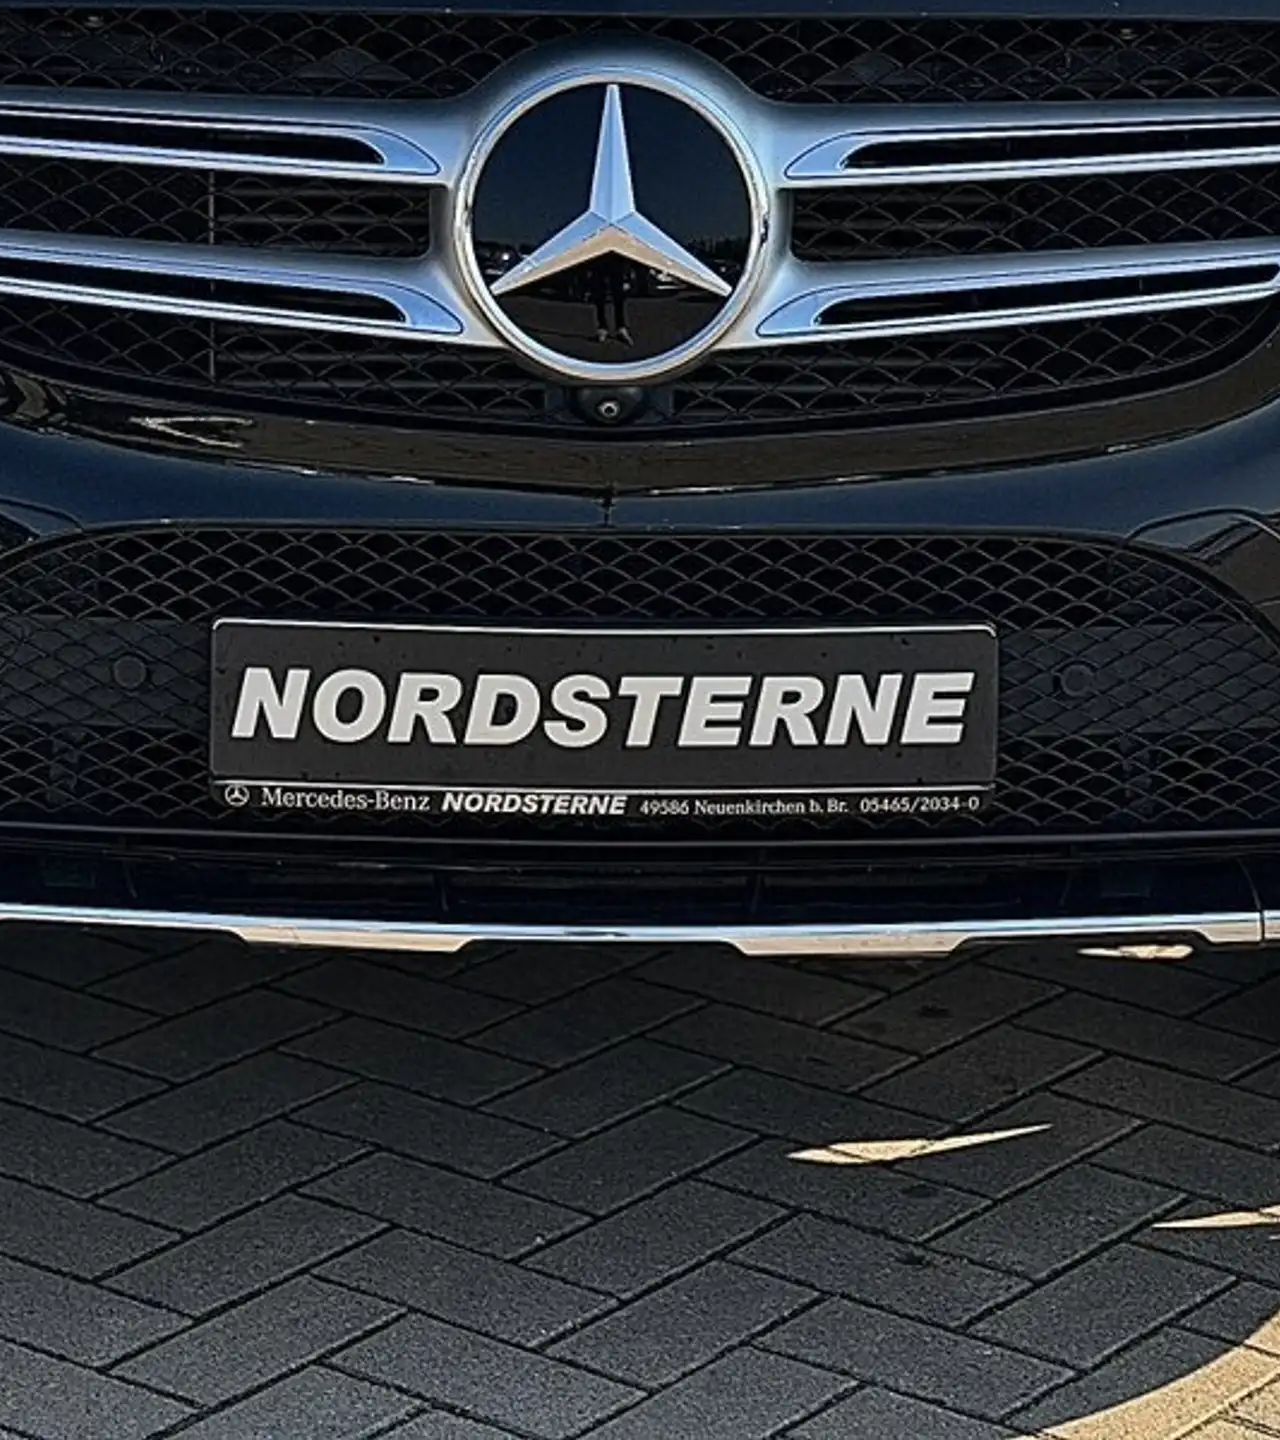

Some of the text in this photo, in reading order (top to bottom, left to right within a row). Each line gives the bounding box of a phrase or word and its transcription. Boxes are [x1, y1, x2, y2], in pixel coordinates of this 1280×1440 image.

[231, 666, 975, 748] NORDSTERNE
[261, 787, 980, 815] Mercedes-Benz NORDSTERNE 49586 Neuenkirchen b. Br. 05465/2034-0
